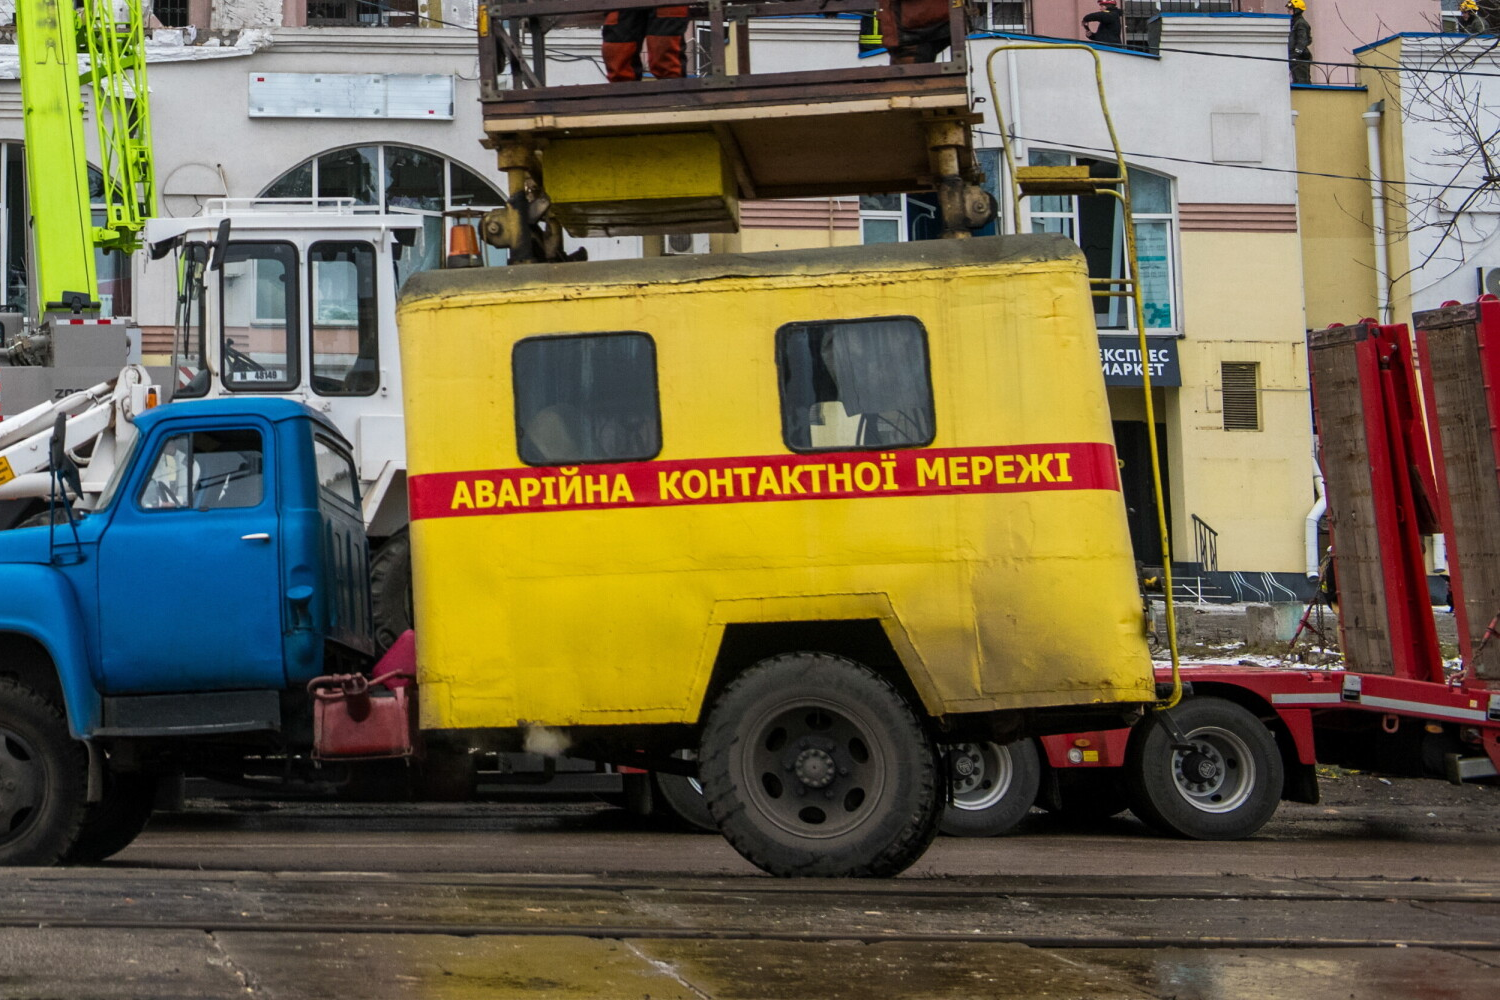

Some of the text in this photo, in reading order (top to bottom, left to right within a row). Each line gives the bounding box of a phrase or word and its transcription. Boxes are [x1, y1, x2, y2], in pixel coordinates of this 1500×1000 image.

[451, 453, 1073, 509] АВАРІЙНА КОНТАКТНОЇ МЕРЕЖІ
